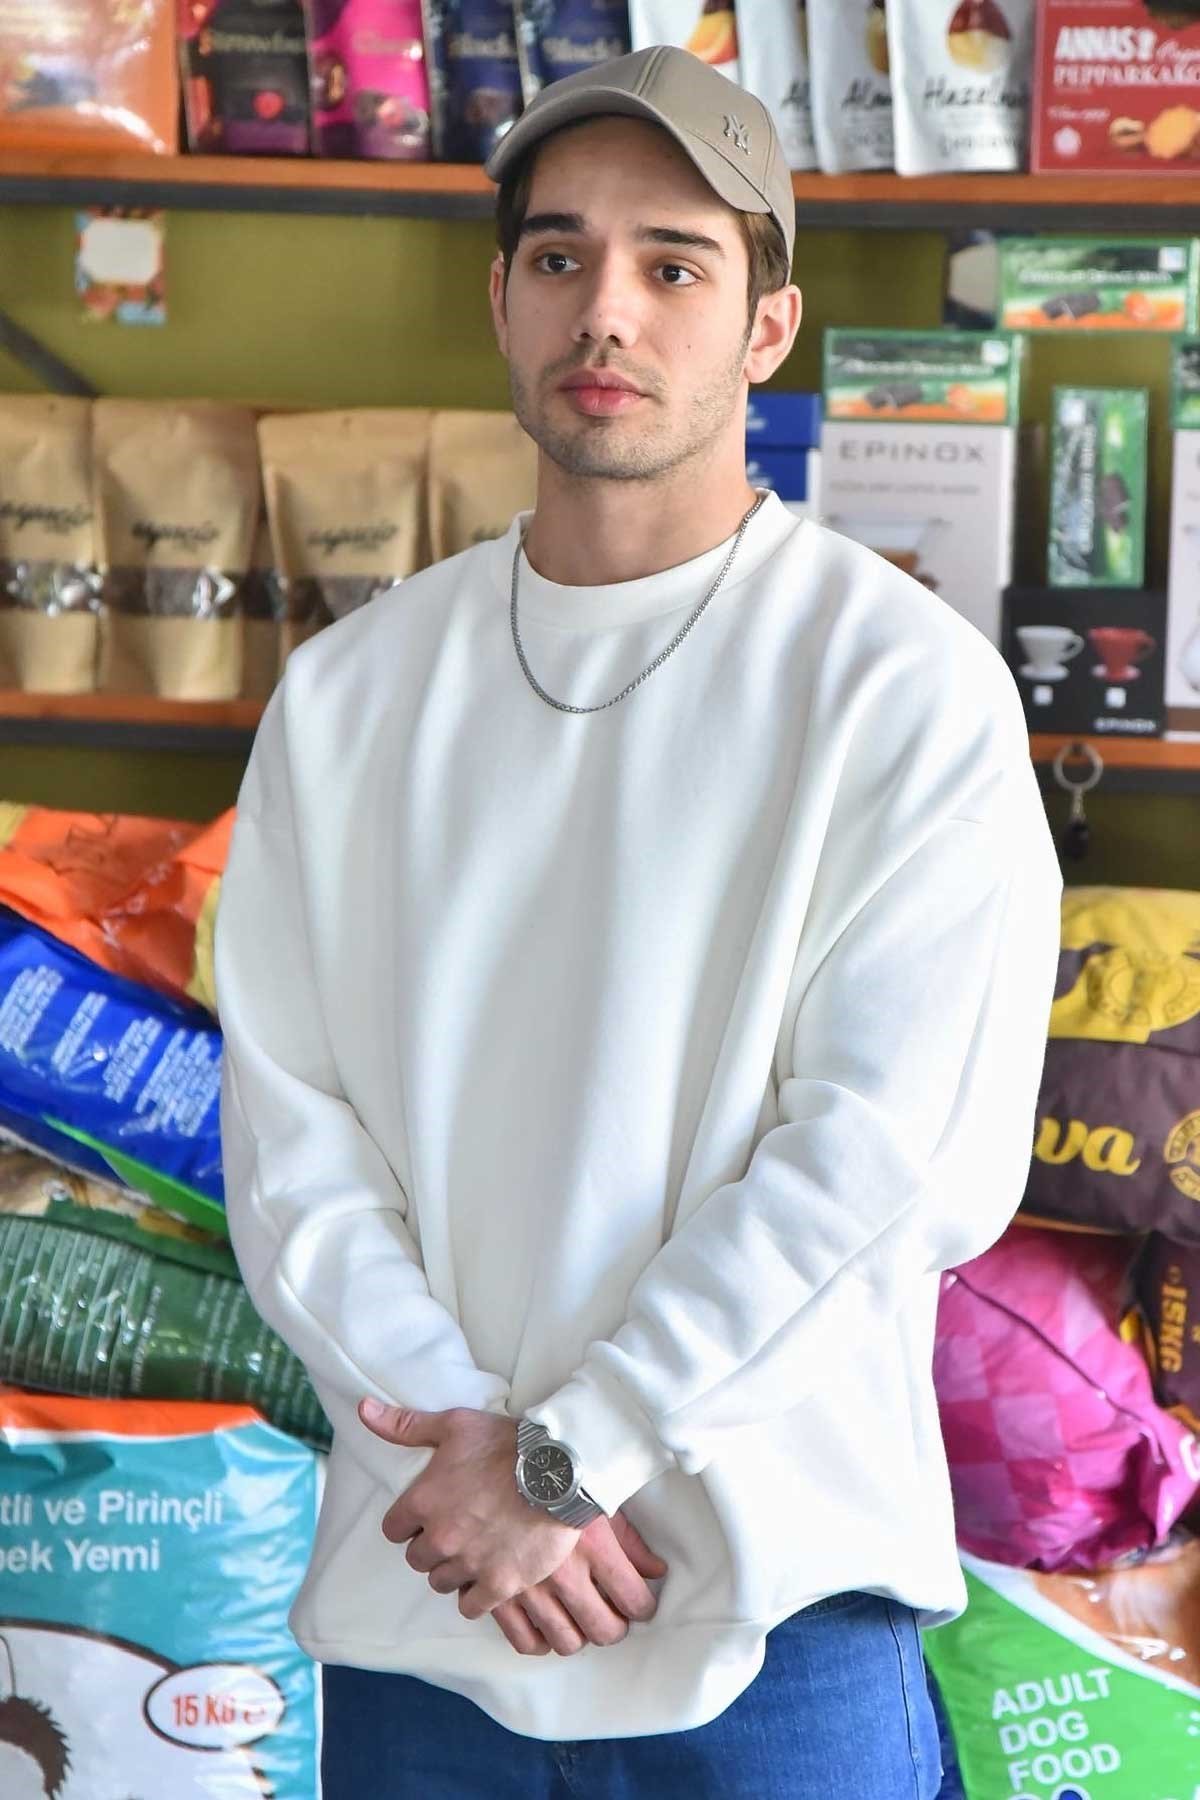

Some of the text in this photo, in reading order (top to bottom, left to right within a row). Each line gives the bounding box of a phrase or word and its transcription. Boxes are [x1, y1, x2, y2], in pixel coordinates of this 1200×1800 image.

[839, 438, 986, 464] EPINOX
[43, 1500, 88, 1526] ve
[98, 1489, 224, 1533] Pirinçli
[64, 1538, 161, 1573] Yemi
[171, 1694, 199, 1727] 15
[991, 1667, 1112, 1720] ADULT
[998, 1710, 1090, 1755] DOG
[1007, 1743, 1122, 1792] FOOD
